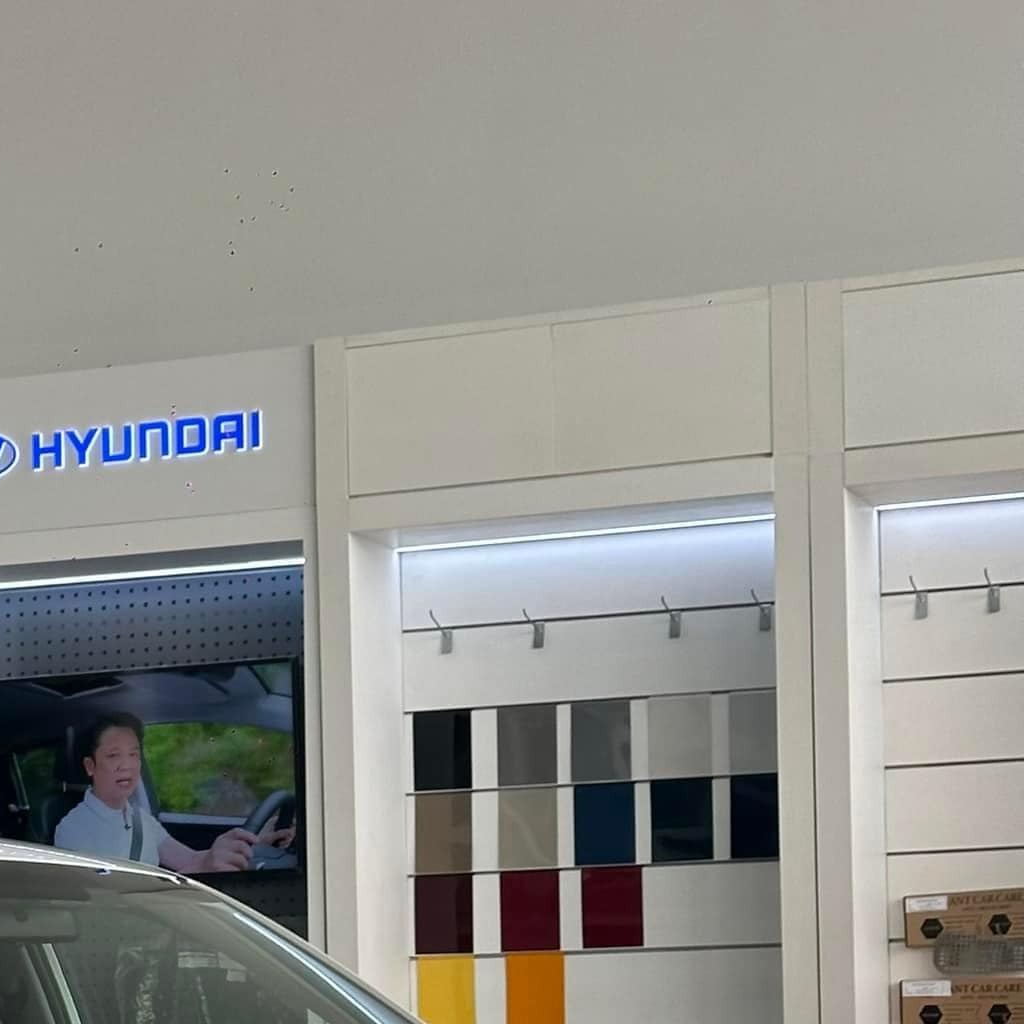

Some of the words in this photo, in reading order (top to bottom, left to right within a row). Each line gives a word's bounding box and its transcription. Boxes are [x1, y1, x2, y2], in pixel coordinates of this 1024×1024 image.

[31, 408, 262, 471] HYUNDAI
[970, 984, 993, 993] CAR
[994, 983, 1022, 993] CARE
